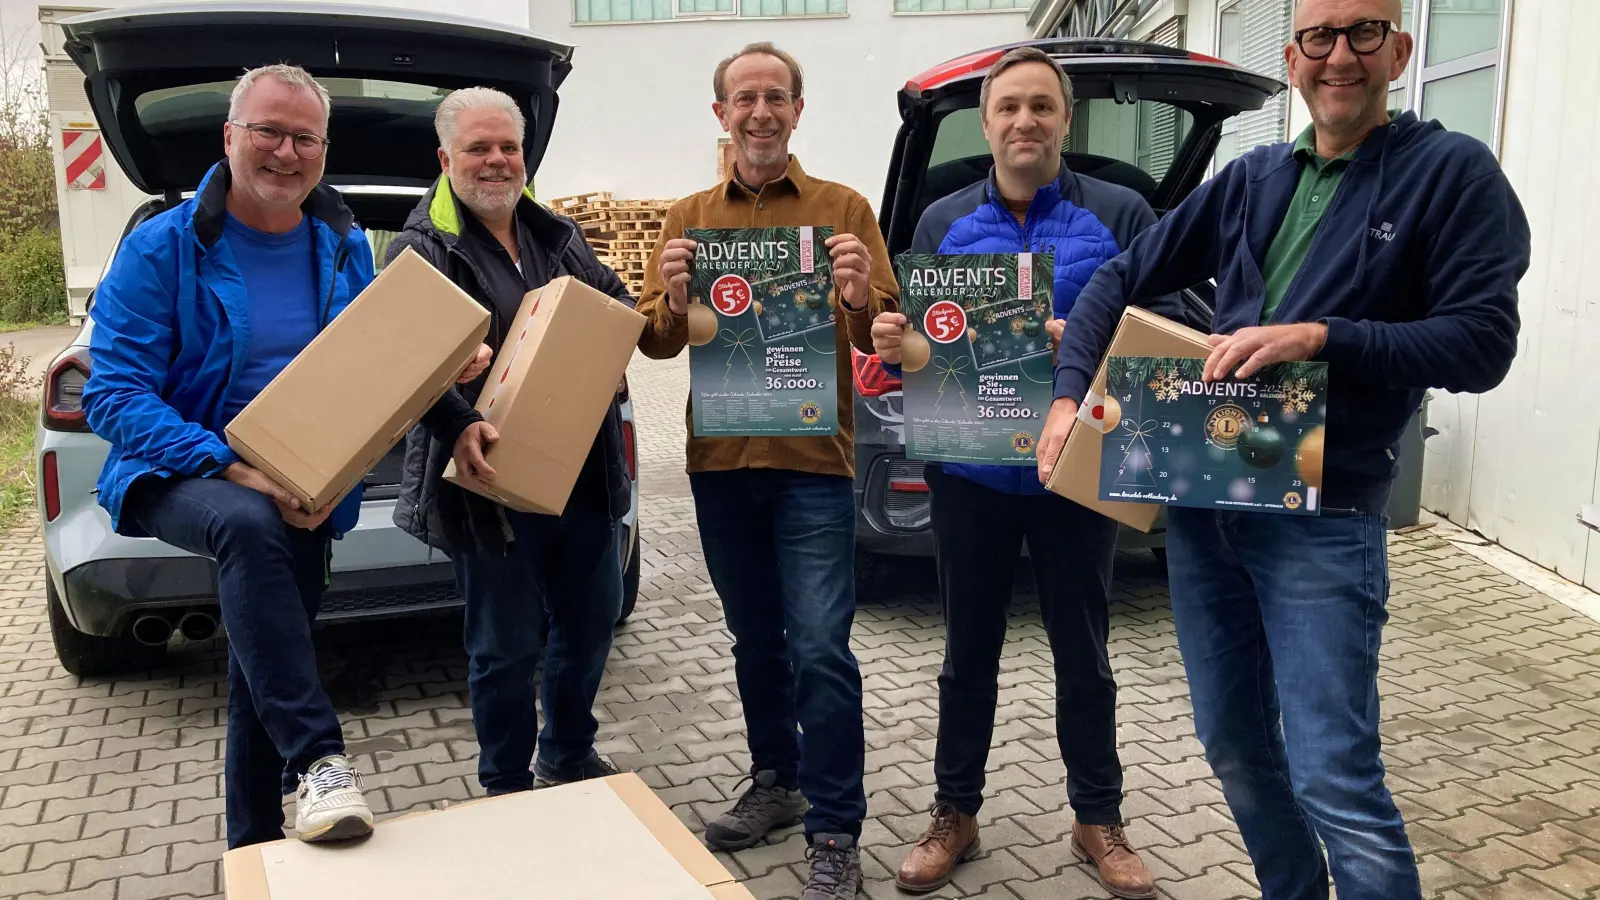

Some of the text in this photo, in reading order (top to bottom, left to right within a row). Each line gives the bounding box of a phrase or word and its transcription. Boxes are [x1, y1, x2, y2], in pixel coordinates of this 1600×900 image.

[695, 241, 788, 260] ADVENTS
[696, 261, 780, 271] KALENDER 2023
[909, 268, 1006, 287] ADVENTS
[780, 280, 808, 292] ADVENTS
[910, 288, 997, 298] KALENDER 2023
[995, 306, 1025, 319] ADVENTS
[766, 345, 804, 354] gewinnen
[765, 356, 801, 366] Preise
[765, 377, 816, 390] 36.000
[979, 373, 1018, 382] gewinnen
[978, 384, 1015, 395] Preise
[1180, 381, 1257, 397] ADVENTS
[977, 405, 1031, 418] 36.000
[1224, 420, 1234, 432] L
